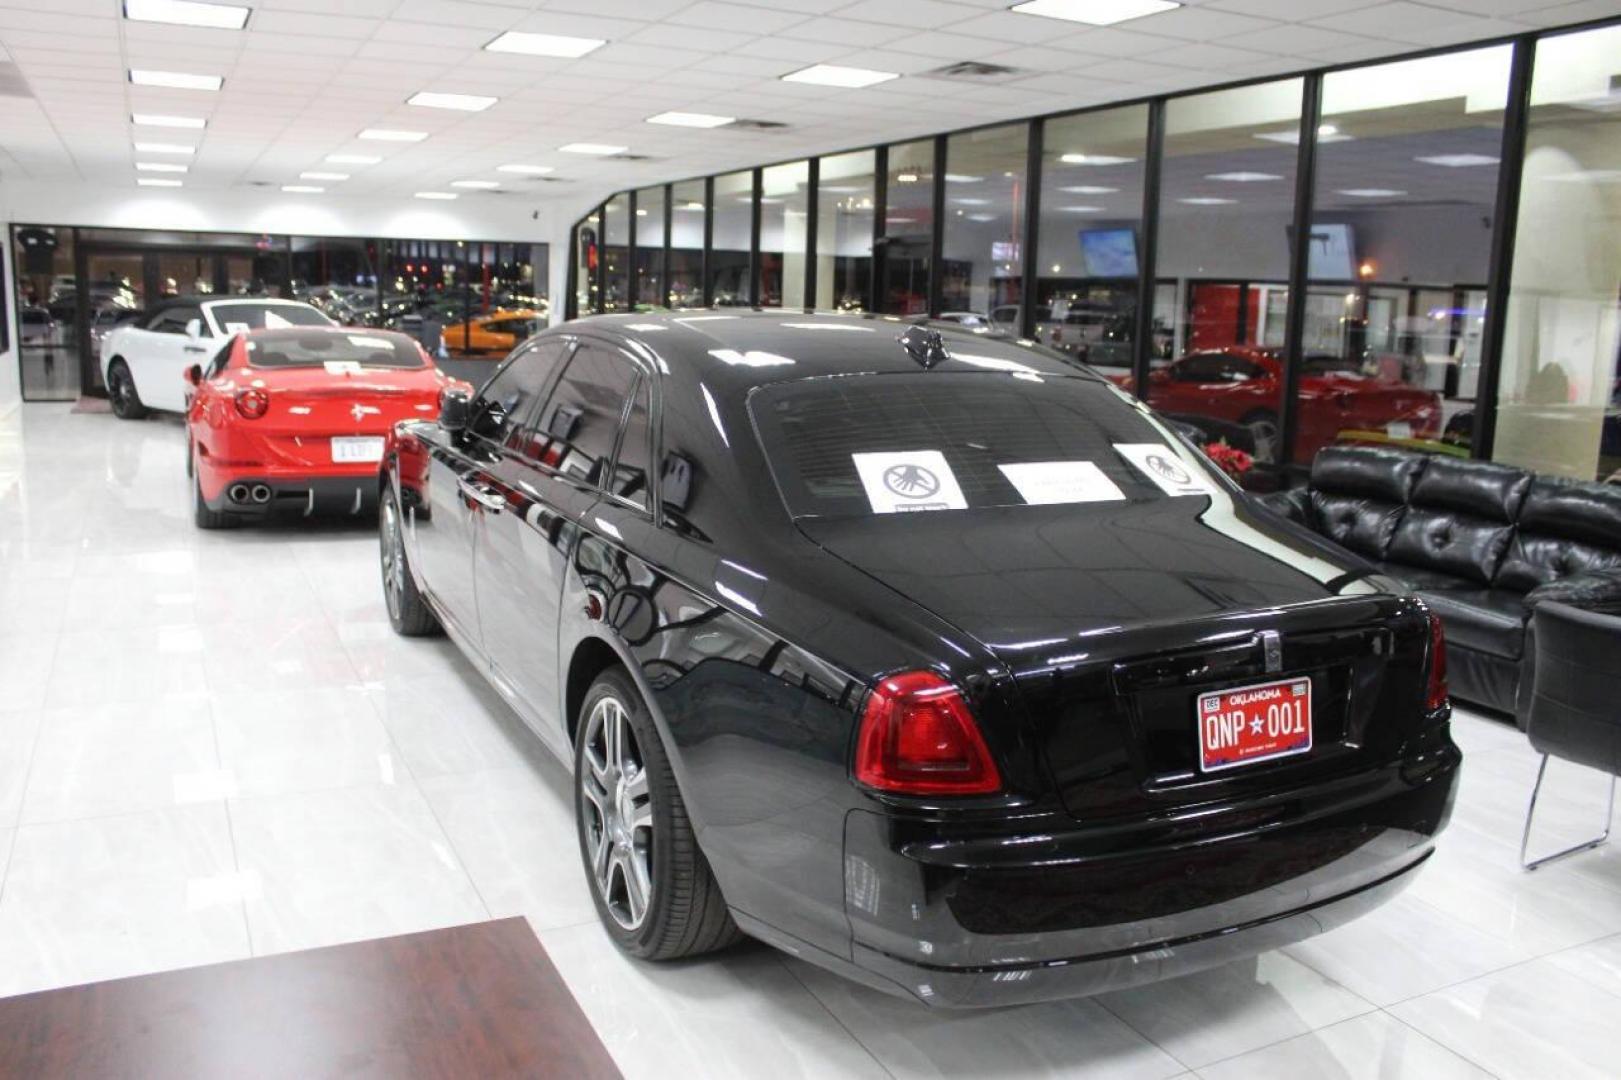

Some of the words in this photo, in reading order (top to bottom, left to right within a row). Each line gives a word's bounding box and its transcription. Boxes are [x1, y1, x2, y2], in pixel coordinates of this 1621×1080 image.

[1206, 699, 1219, 710] DEC
[1230, 688, 1281, 705] OKLAHOMA
[1206, 711, 1245, 750] QNP
[1267, 700, 1305, 737] 001
